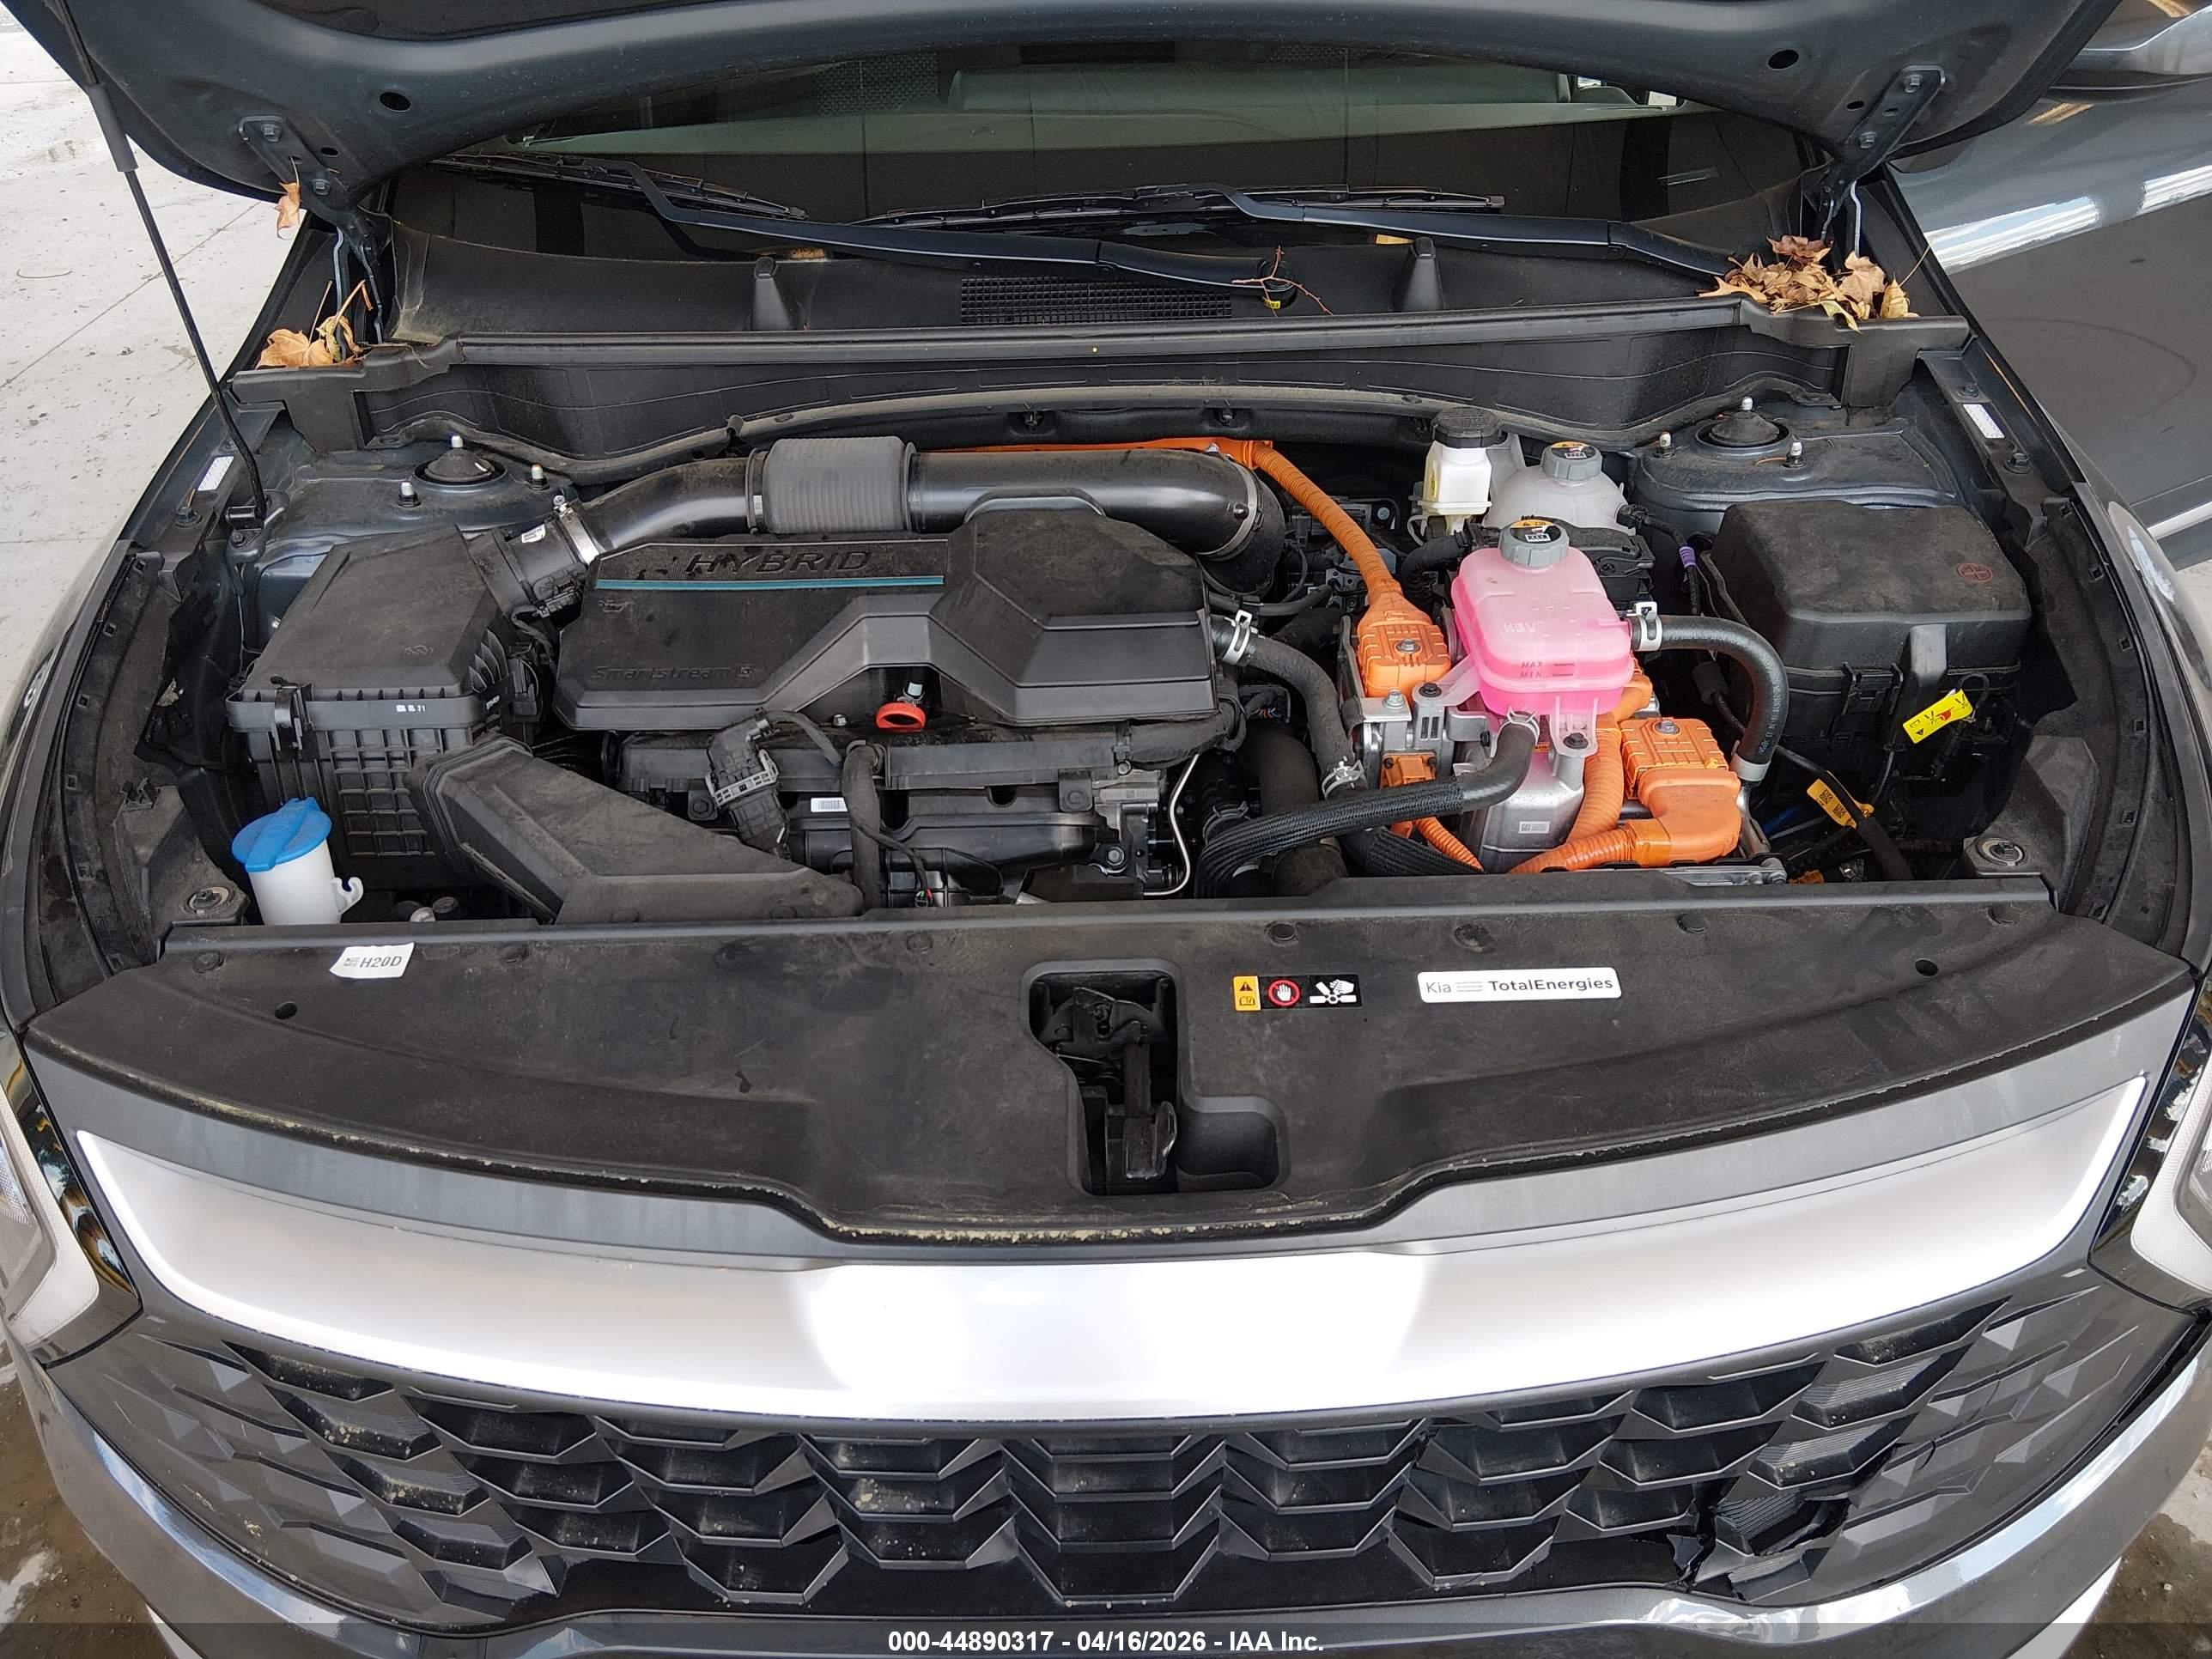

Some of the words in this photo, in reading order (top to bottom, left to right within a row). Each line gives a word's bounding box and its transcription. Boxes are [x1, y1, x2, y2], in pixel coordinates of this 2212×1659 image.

[685, 550, 872, 574] HYBRID
[591, 665, 730, 681] Smartstream
[1426, 981, 1452, 994] Kia
[1488, 978, 1613, 992] TotalEnergies
